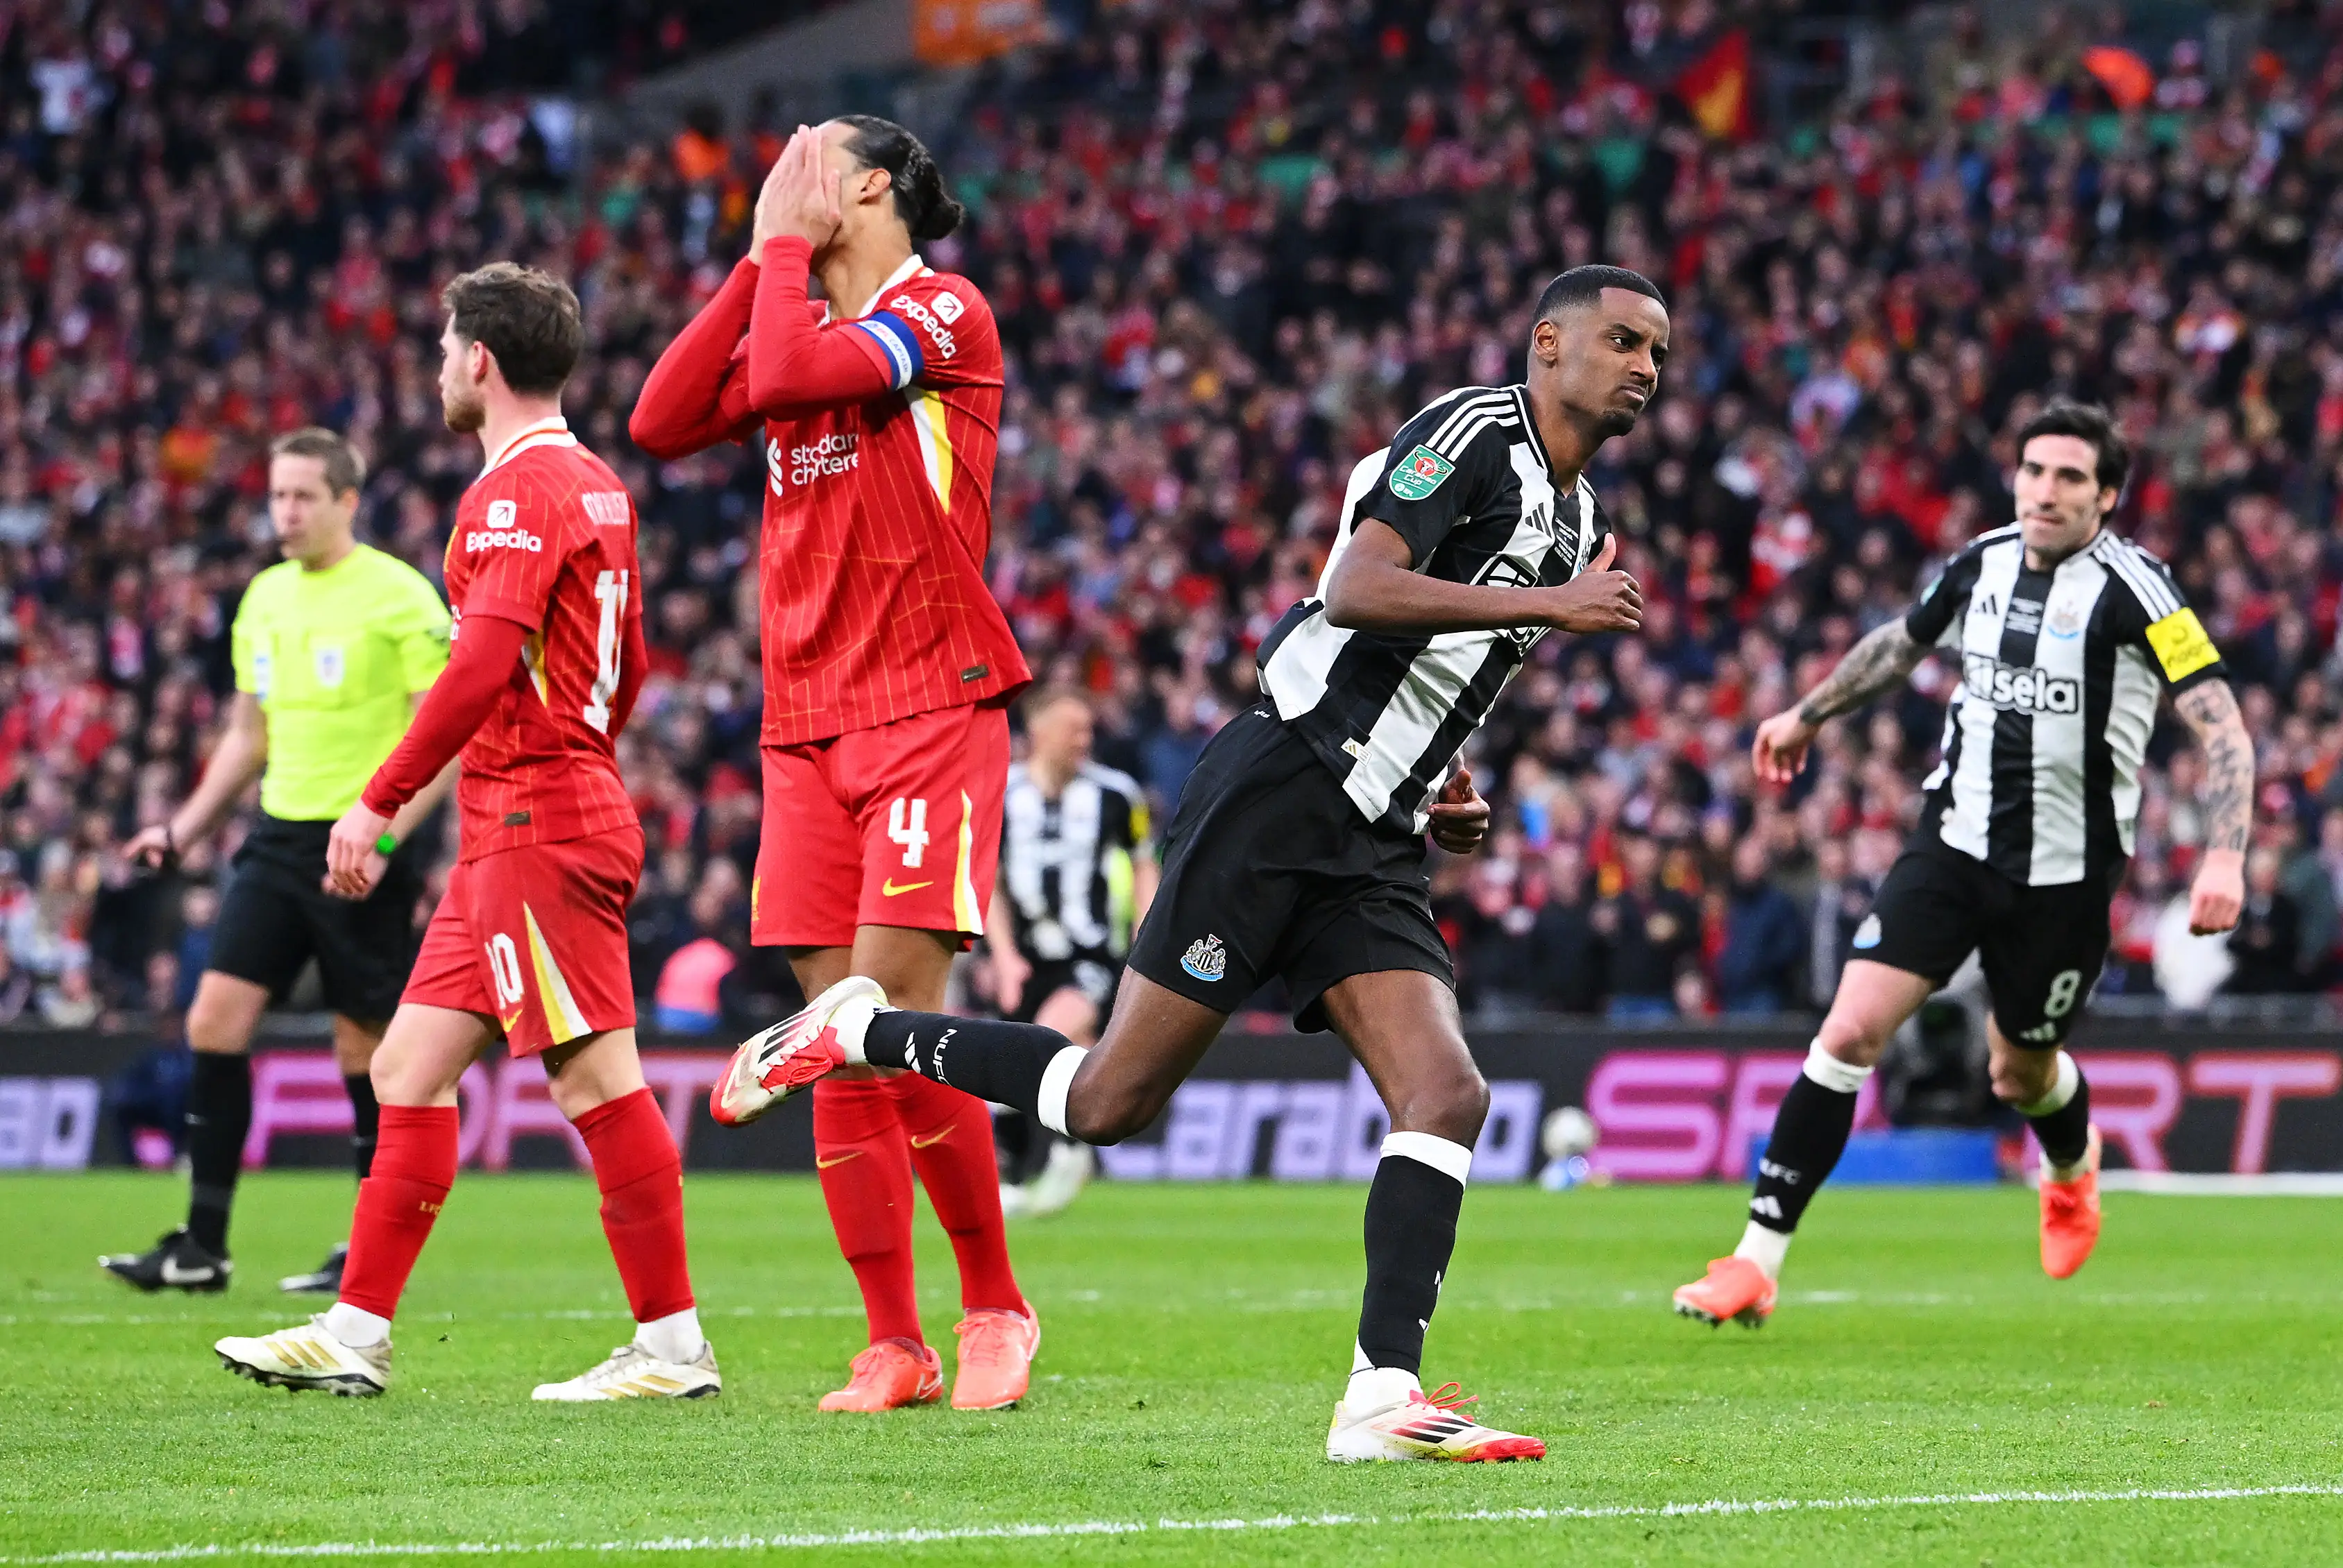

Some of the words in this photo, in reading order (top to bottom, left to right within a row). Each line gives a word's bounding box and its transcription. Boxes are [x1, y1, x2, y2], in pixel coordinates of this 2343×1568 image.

[891, 294, 957, 359] Expedia
[1399, 466, 1437, 485] Carabao
[1404, 475, 1423, 486] Cup
[466, 529, 542, 553] Expedia
[888, 797, 929, 869] 4
[2044, 969, 2082, 1018] 8
